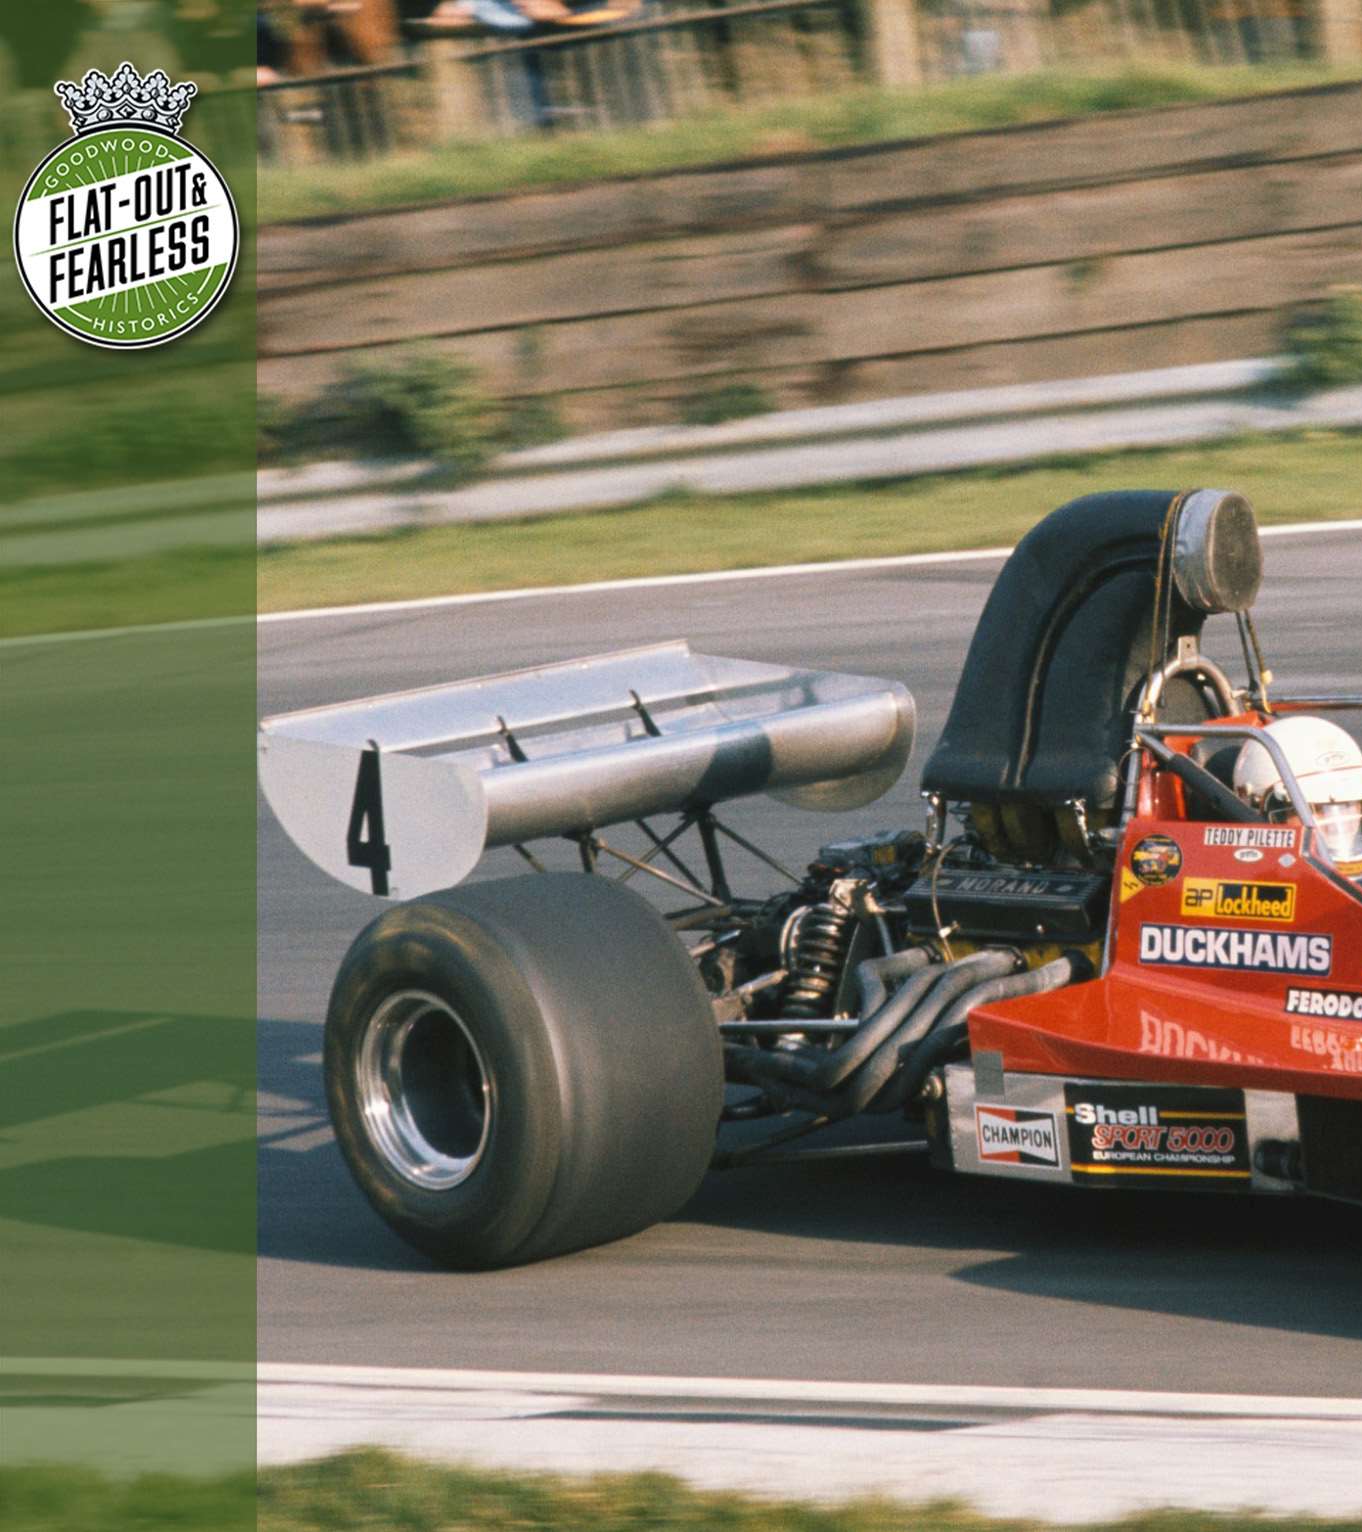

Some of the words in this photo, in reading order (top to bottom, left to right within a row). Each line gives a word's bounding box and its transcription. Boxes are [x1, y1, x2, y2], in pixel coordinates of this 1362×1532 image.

[346, 749, 391, 896] 4
[1206, 828, 1243, 845] TEDDY
[1247, 830, 1294, 848] PILETTE
[1215, 884, 1292, 919] Lockheed
[1140, 924, 1331, 972] DUCKHAMS
[1074, 1102, 1159, 1126] Shell
[982, 1122, 1054, 1148] CHAMPION
[1091, 1123, 1169, 1152] SPORT
[1166, 1124, 1235, 1153] 5000
[1092, 1150, 1152, 1161] EUROPEAN
[1153, 1151, 1236, 1164] CHAMPIONSHIP
